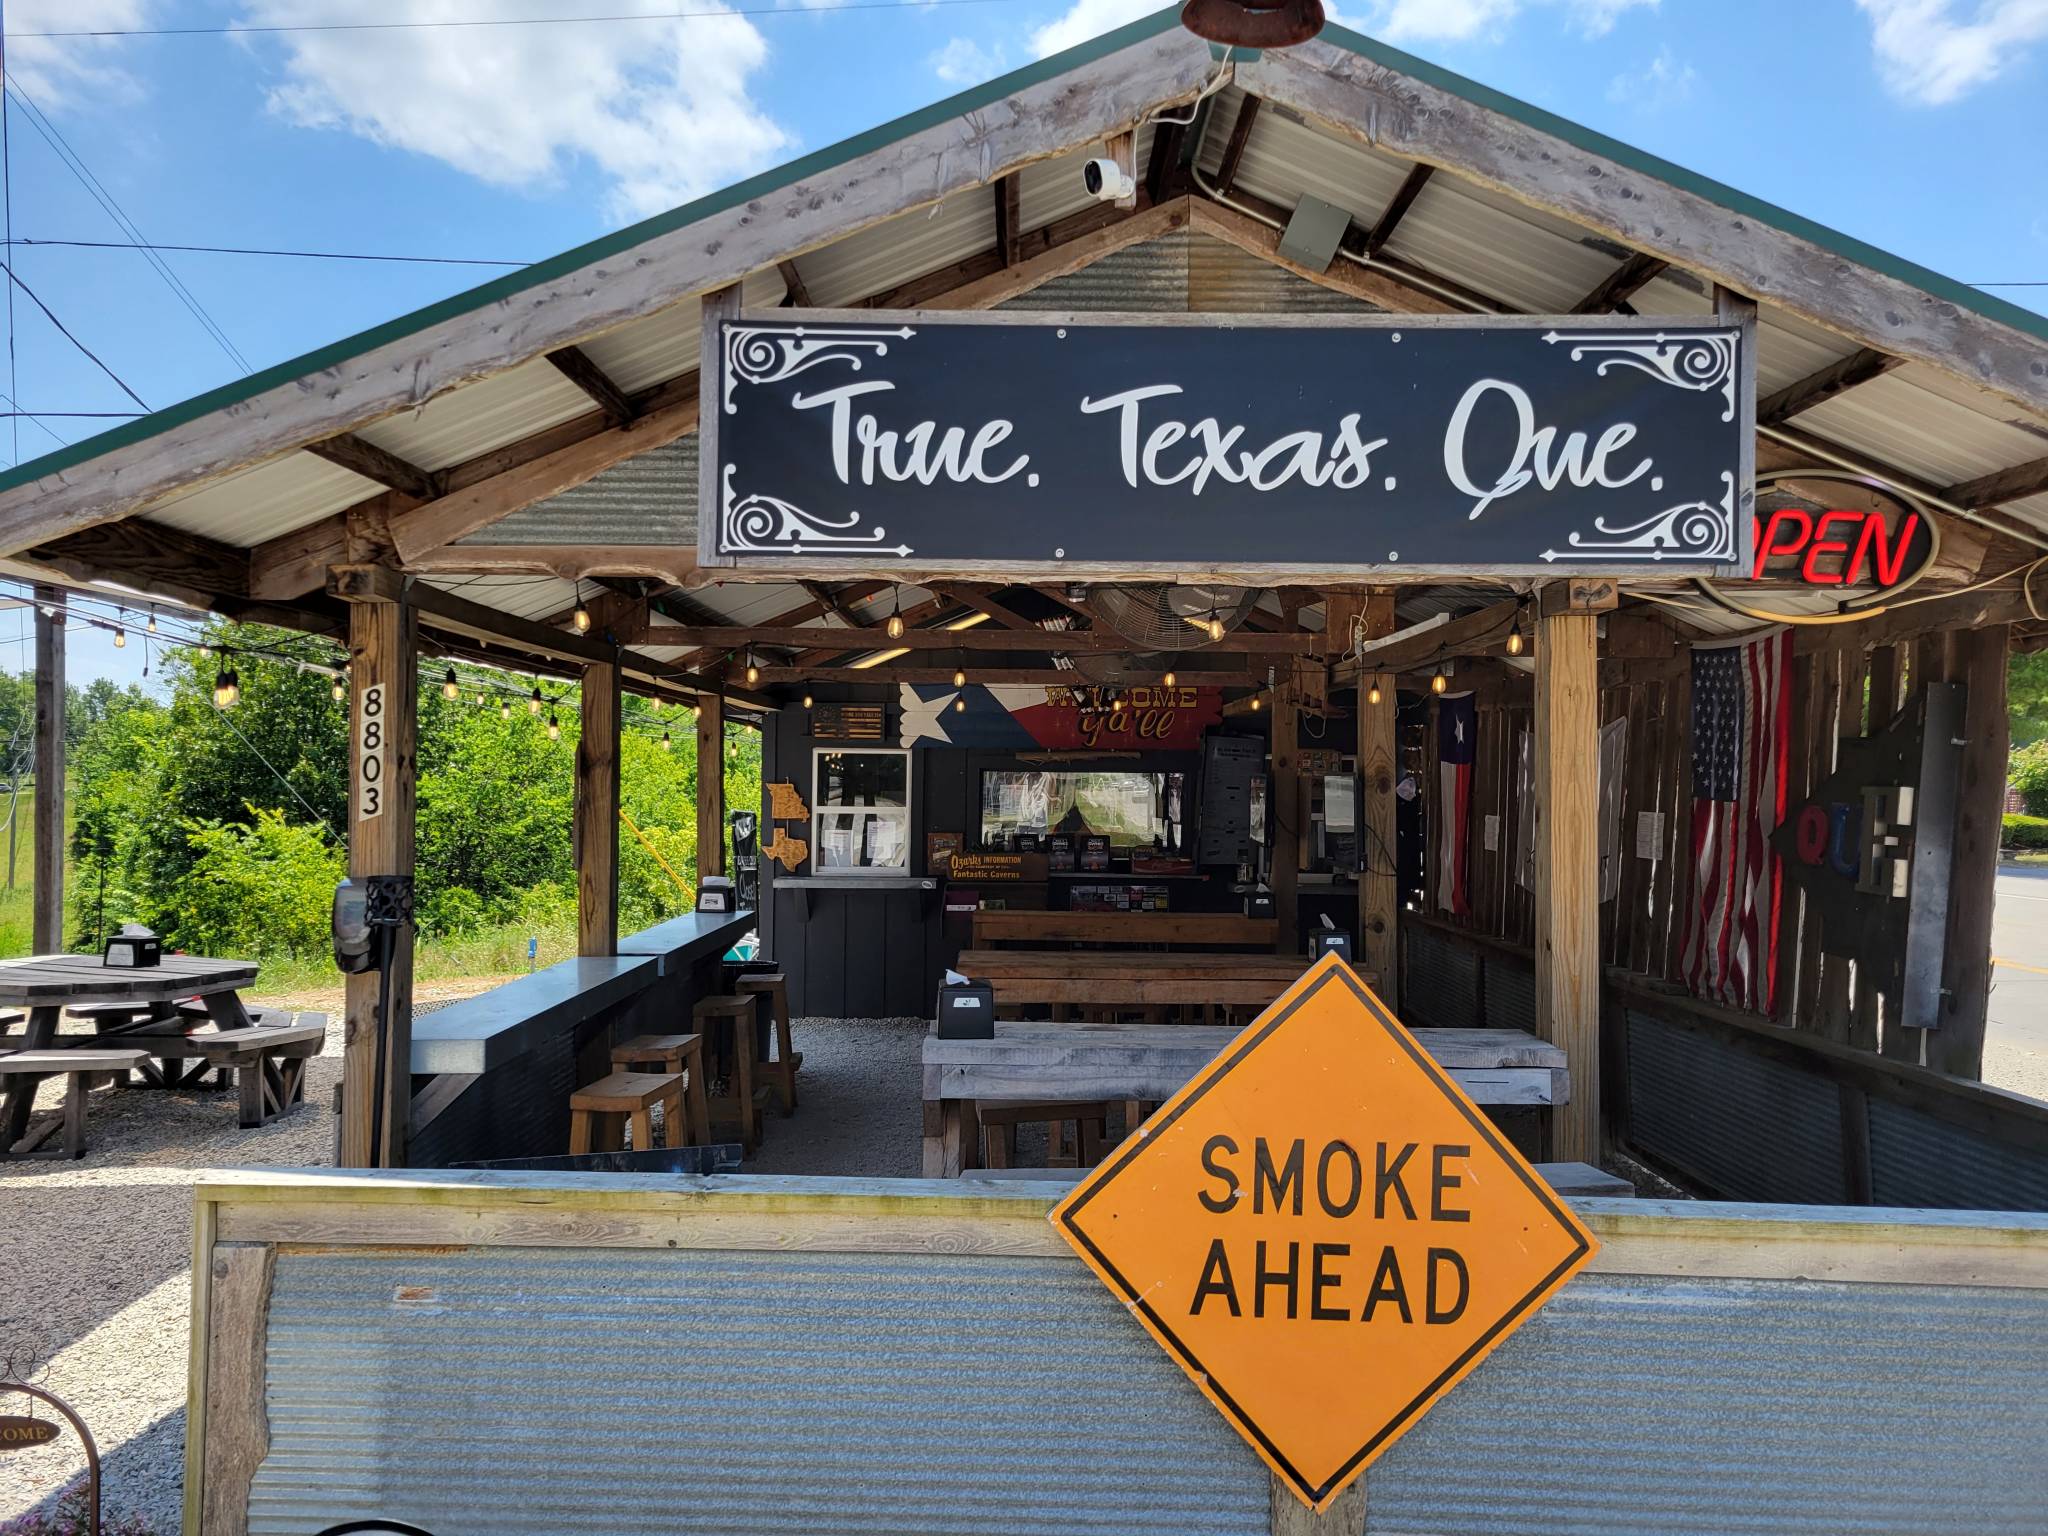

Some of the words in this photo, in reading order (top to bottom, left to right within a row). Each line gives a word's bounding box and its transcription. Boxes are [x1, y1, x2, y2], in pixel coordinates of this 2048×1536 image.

[791, 380, 1040, 488] True.
[1080, 384, 1397, 496] Texas.
[1443, 378, 1664, 521] Que.
[1752, 509, 1919, 587] PEN
[362, 688, 382, 815] 8803
[953, 870, 988, 878] Fantastic
[990, 870, 1020, 878] Caverns
[983, 855, 1022, 865] INFORMATION
[1197, 1134, 1471, 1223] SMOKE
[1189, 1238, 1470, 1325] AHEAD
[0, 1426, 49, 1441] OME
